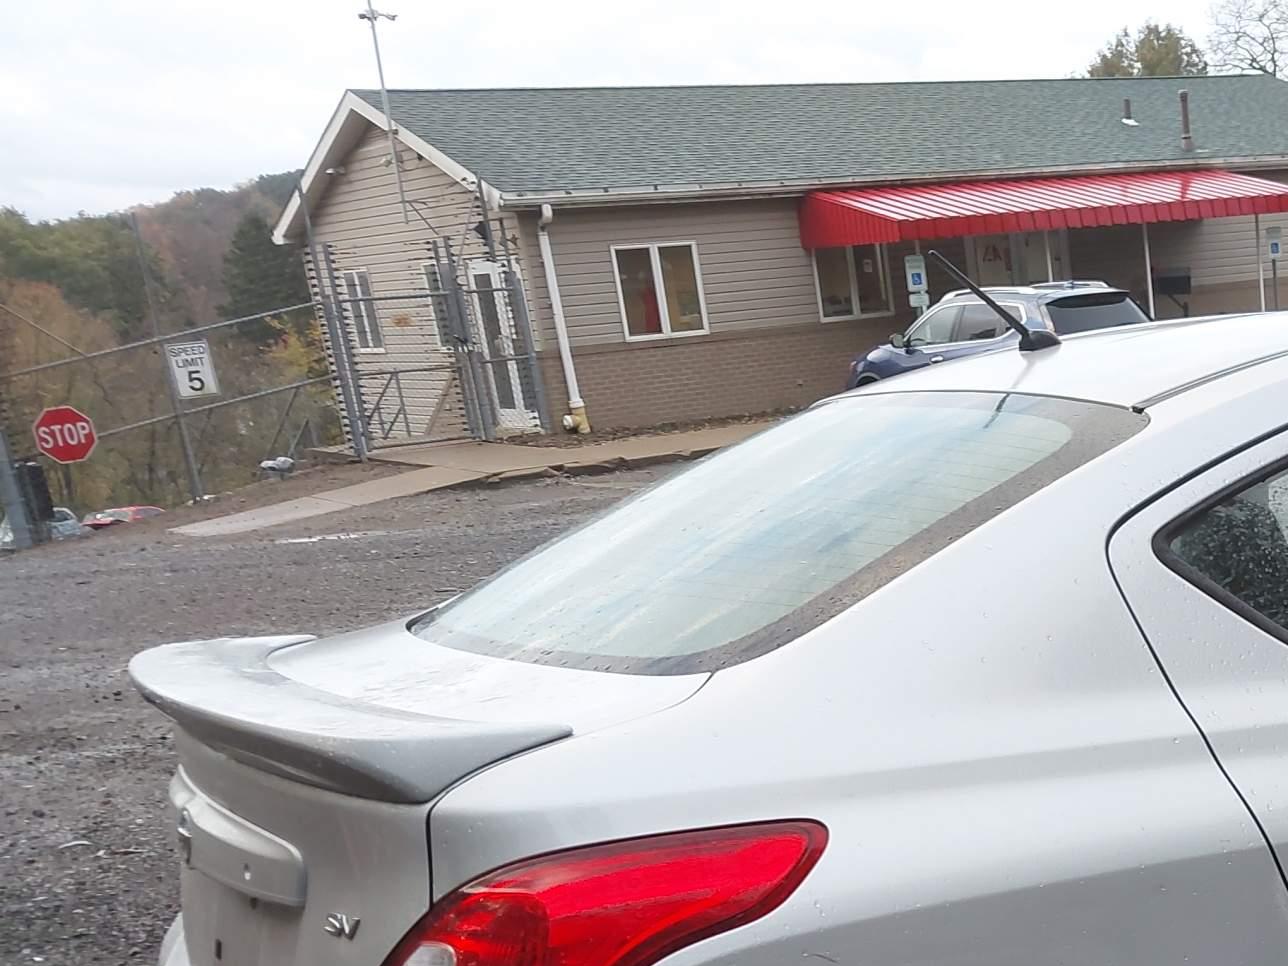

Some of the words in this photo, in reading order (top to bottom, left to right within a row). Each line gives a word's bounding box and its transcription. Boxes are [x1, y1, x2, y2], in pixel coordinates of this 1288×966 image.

[169, 345, 205, 358] SPEED
[175, 356, 205, 369] LIMIT
[188, 370, 205, 392] 5
[38, 421, 91, 449] STOP
[323, 911, 361, 941] SV
